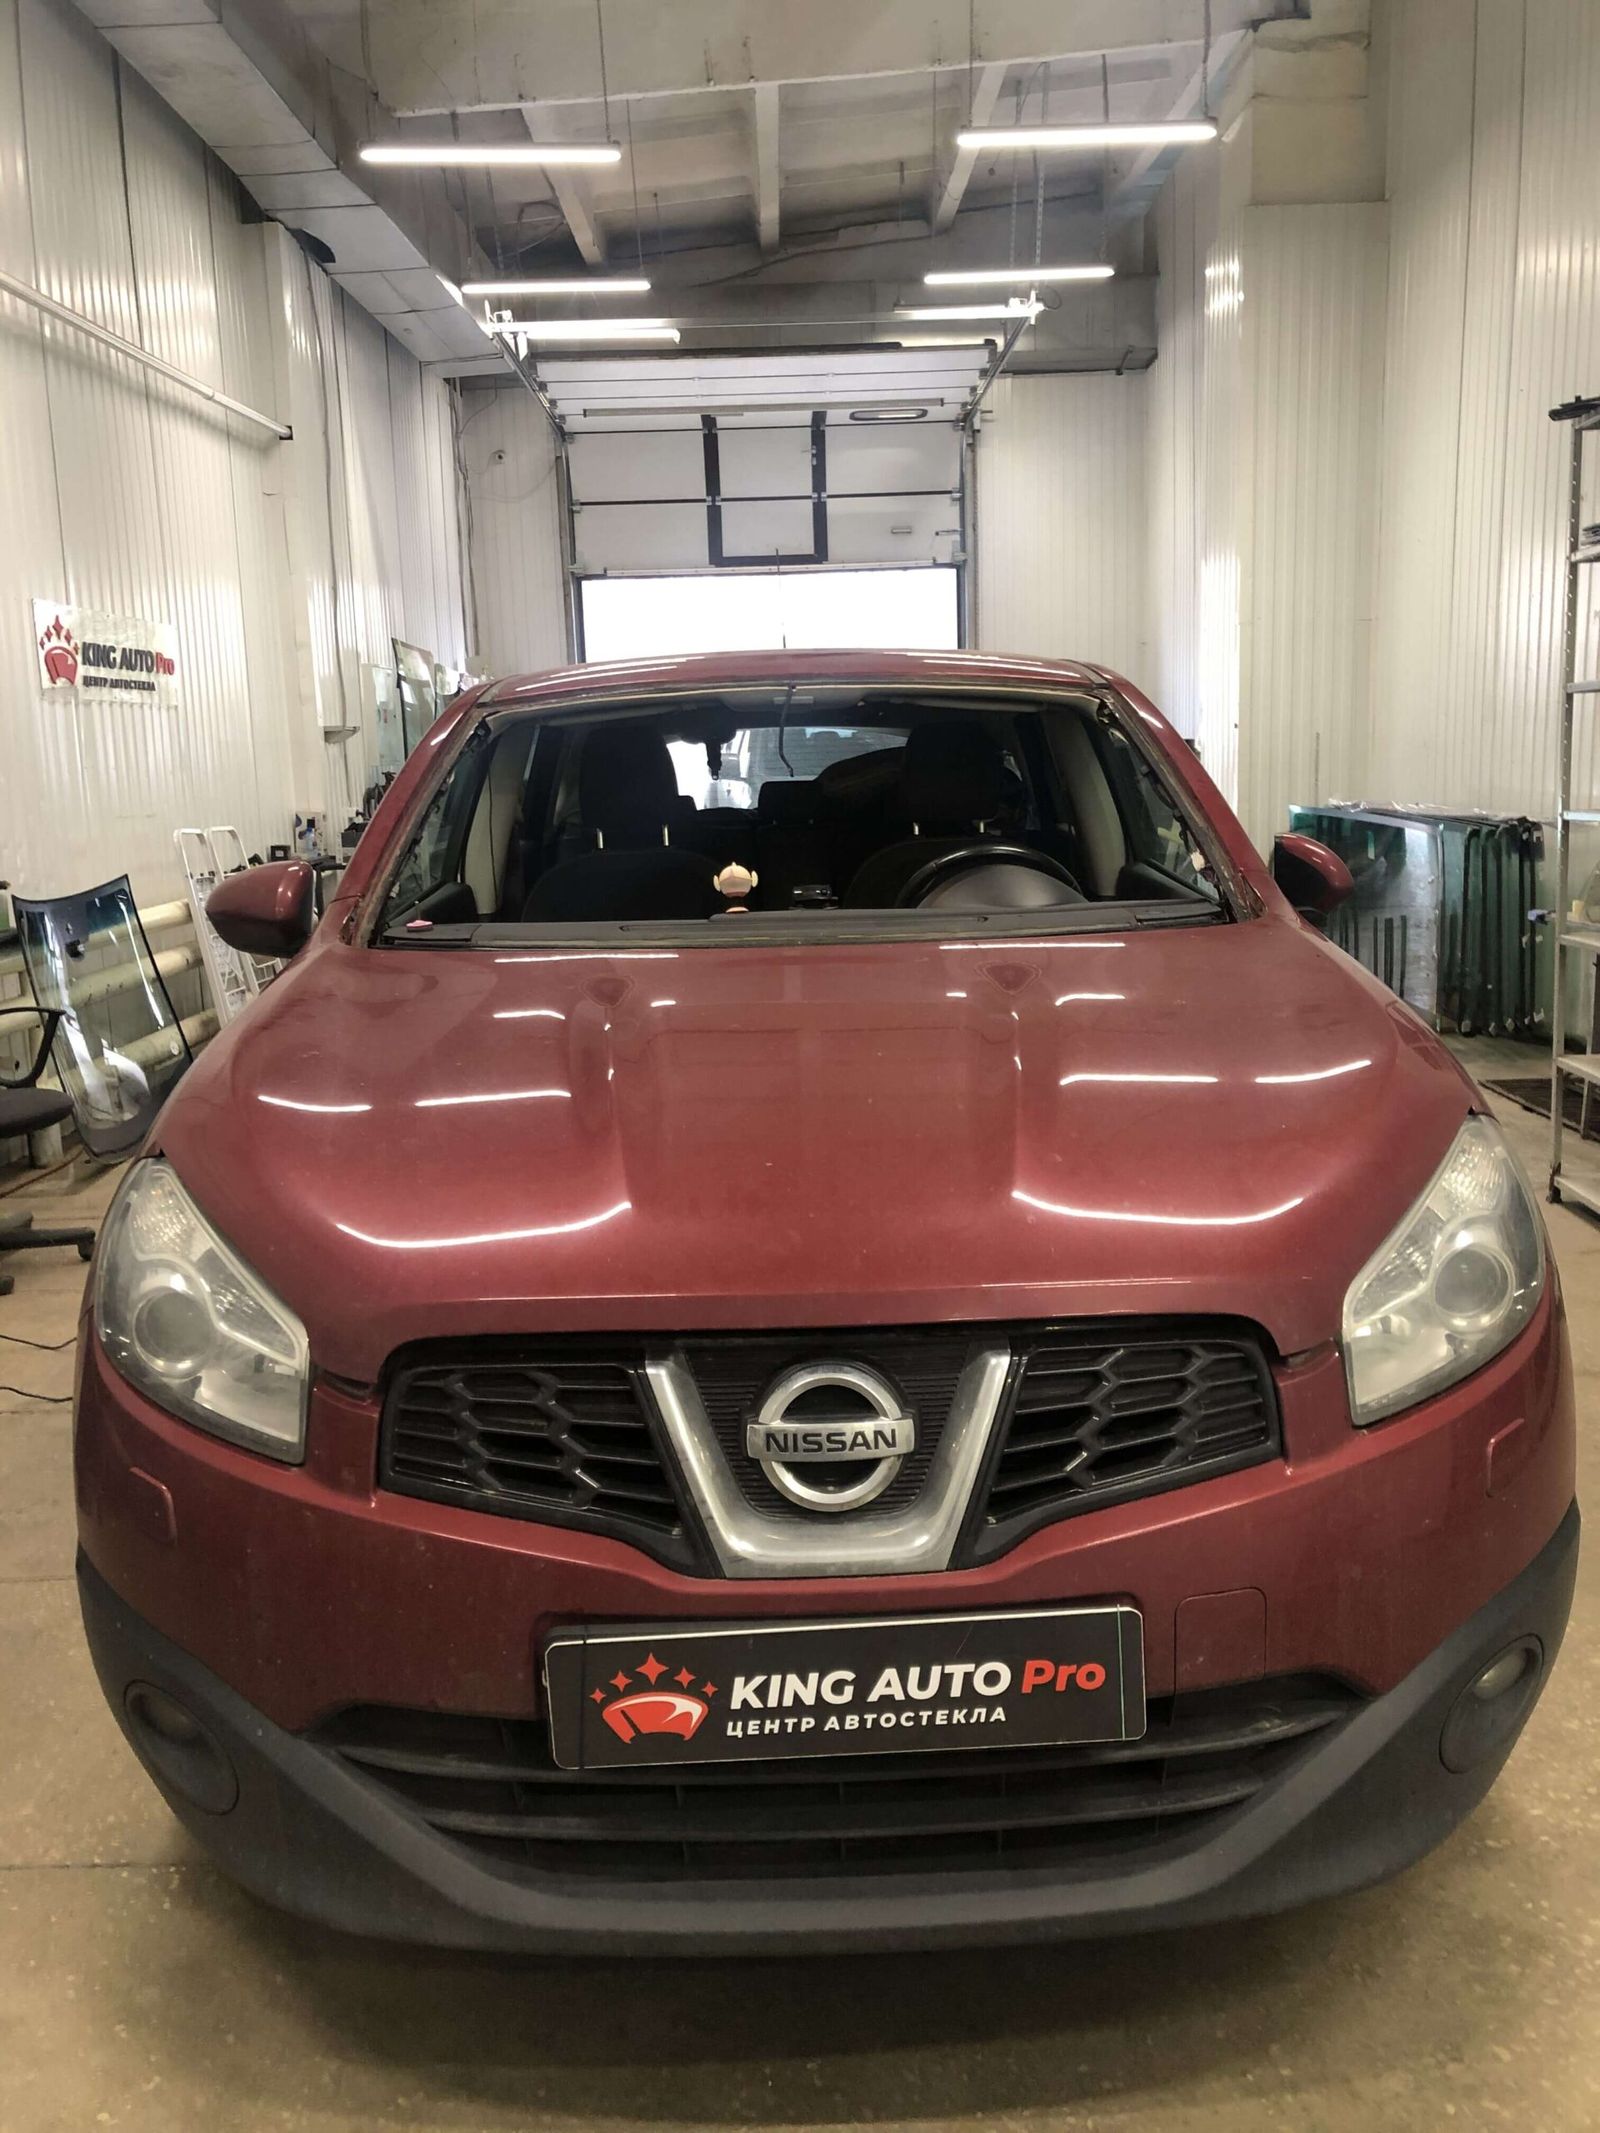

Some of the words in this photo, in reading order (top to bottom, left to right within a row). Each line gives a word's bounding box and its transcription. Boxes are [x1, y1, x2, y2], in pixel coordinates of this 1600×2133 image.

[82, 641, 117, 669] KING
[119, 647, 155, 673] AUTO
[155, 652, 175, 676] Pro
[82, 675, 109, 688] ЦЕНТР
[765, 1429, 897, 1453] NISSAN
[730, 1670, 857, 1710] KING
[866, 1661, 1012, 1703] AUTO
[1021, 1660, 1106, 1694] Pro
[726, 1717, 816, 1739] ЦЕНТР
[823, 1707, 1007, 1732] АВТОСТЕКЛА
